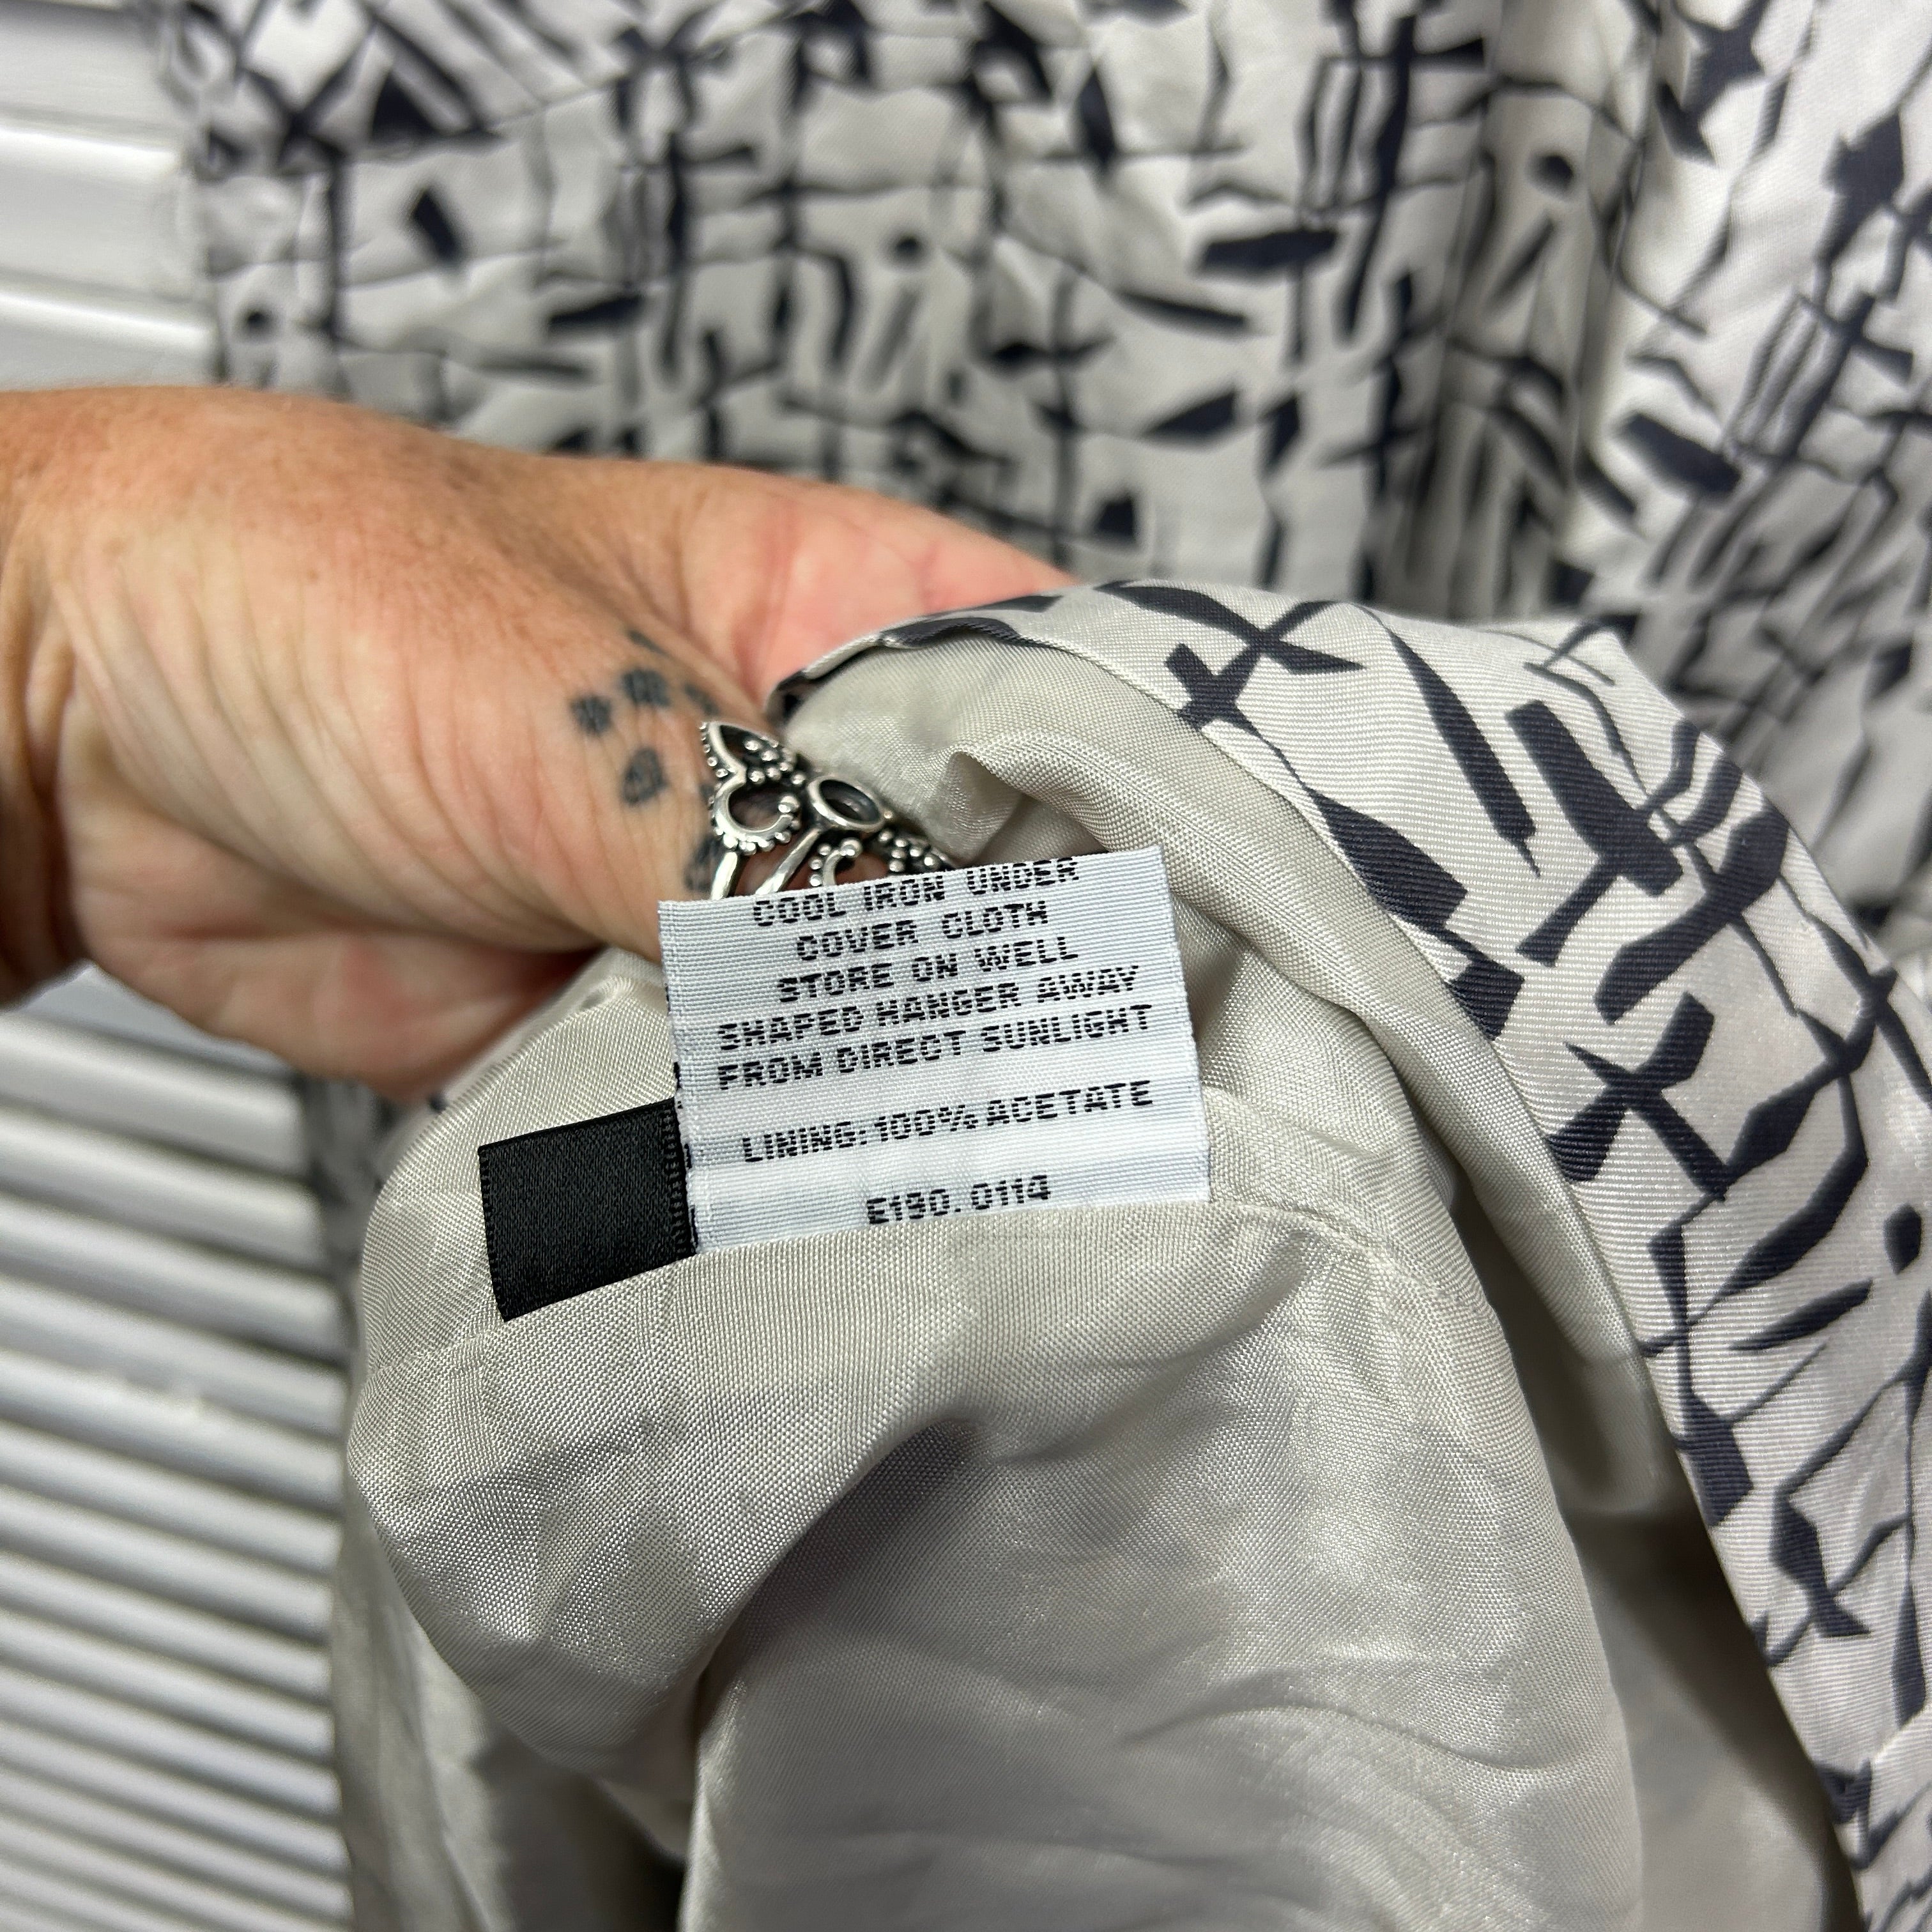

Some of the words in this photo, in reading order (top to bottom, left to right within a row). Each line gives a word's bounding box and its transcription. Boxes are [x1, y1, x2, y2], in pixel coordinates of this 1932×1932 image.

[753, 892, 847, 926] COOL
[864, 875, 944, 912] IRON
[967, 857, 1079, 895] UNDER
[797, 919, 918, 960] COVER
[942, 900, 1048, 940] CLOTH
[777, 962, 893, 1003] STORE
[912, 953, 957, 982] ON
[974, 937, 1078, 972] WELL
[719, 1006, 864, 1051] SHAPED
[876, 982, 1020, 1027] HANGER
[1037, 965, 1139, 1003] AWAY
[718, 1054, 823, 1090] FROM
[838, 1031, 966, 1074] DIRECT
[981, 1004, 1152, 1052] SUNLIGHT
[986, 1080, 1153, 1126] ACETATE
